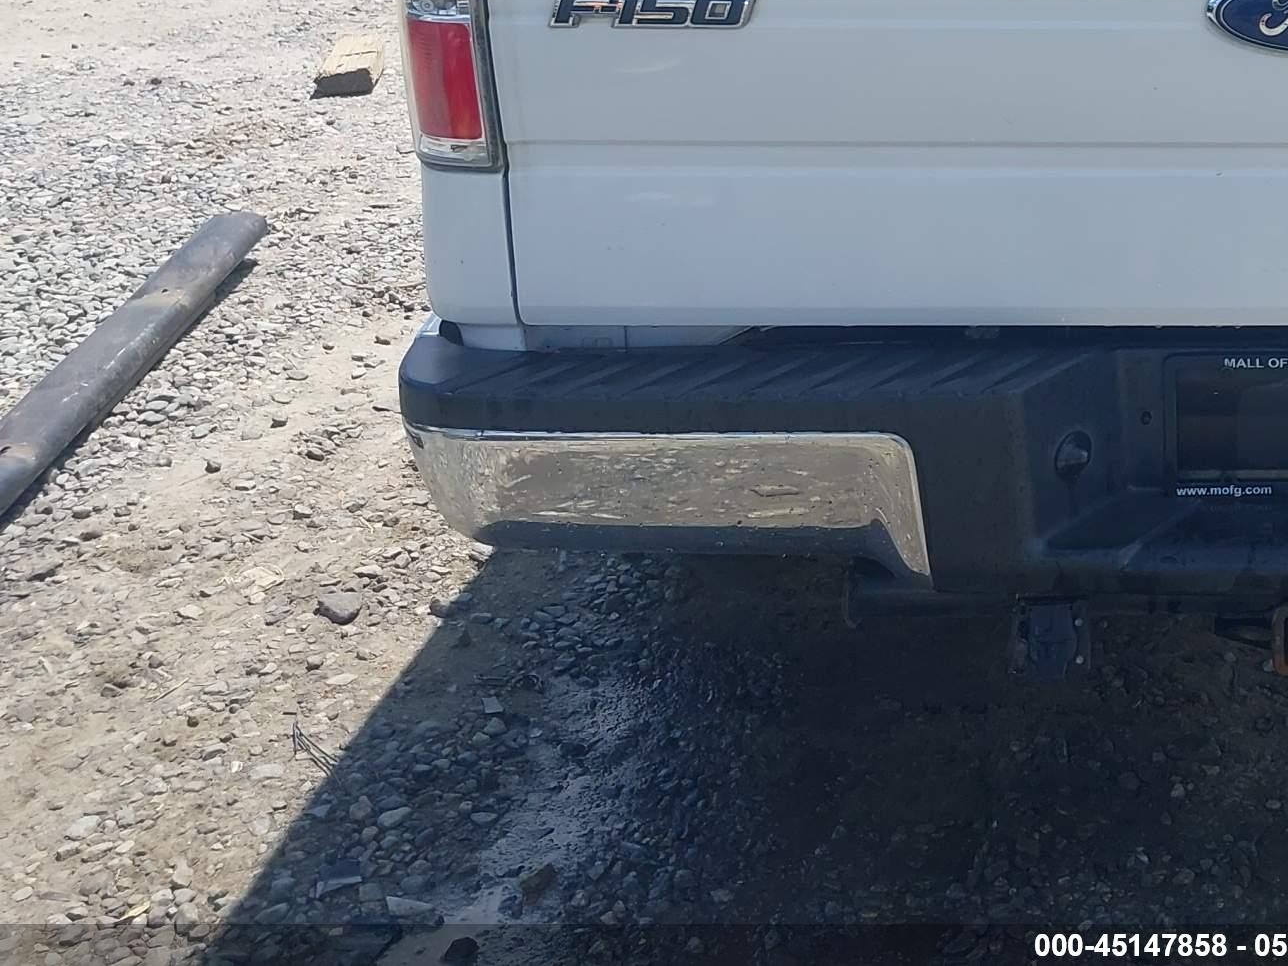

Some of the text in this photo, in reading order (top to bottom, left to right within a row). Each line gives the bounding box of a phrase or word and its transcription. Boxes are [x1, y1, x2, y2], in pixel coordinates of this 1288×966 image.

[1224, 357, 1264, 369] MALL
[1268, 357, 1288, 369] OF
[1176, 485, 1272, 497] www.mofg.com
